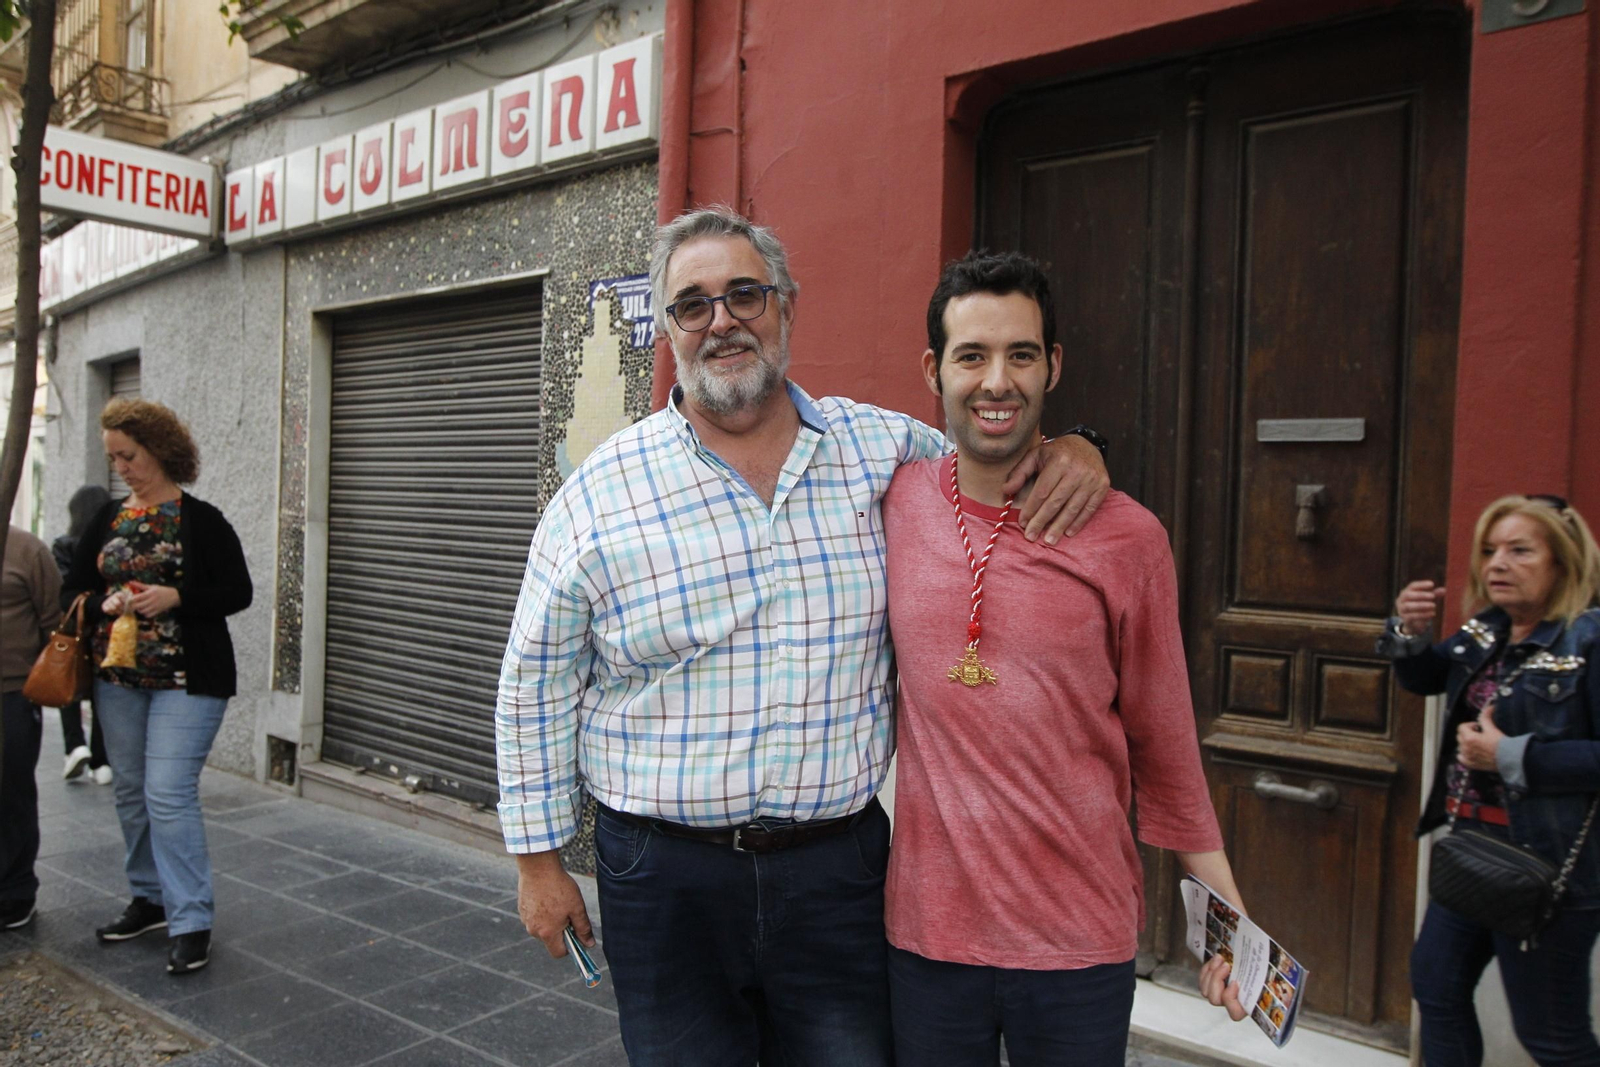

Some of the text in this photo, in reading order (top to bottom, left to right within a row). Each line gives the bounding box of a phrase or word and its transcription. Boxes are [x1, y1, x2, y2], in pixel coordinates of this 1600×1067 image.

[40, 145, 209, 218] CONFITERIA
[228, 57, 641, 233] LA COLMENA
